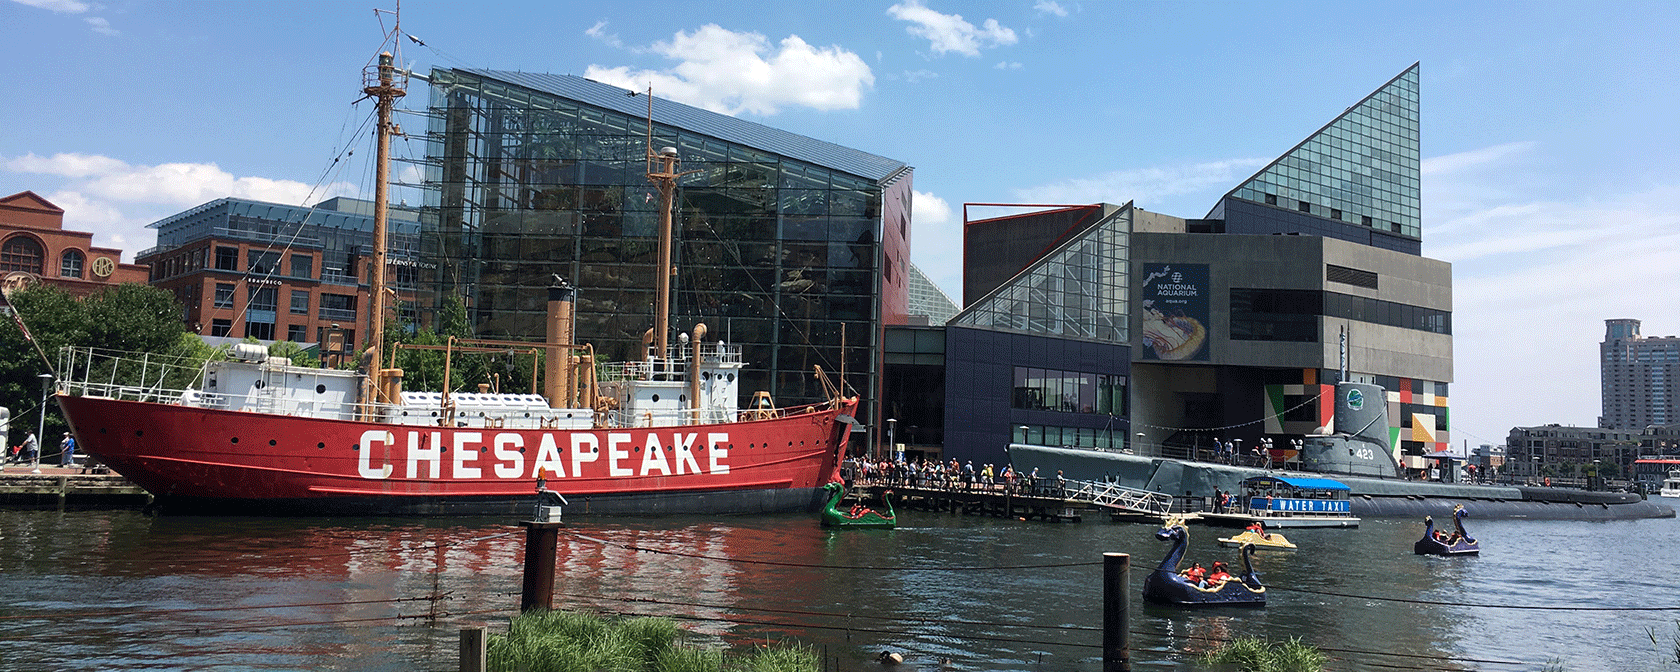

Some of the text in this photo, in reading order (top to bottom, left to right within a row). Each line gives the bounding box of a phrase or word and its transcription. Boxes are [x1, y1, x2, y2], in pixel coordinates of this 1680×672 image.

[357, 430, 730, 479] CHESAPEAKE
[1356, 448, 1374, 460] 423
[1279, 500, 1344, 511] WATER TAXI
